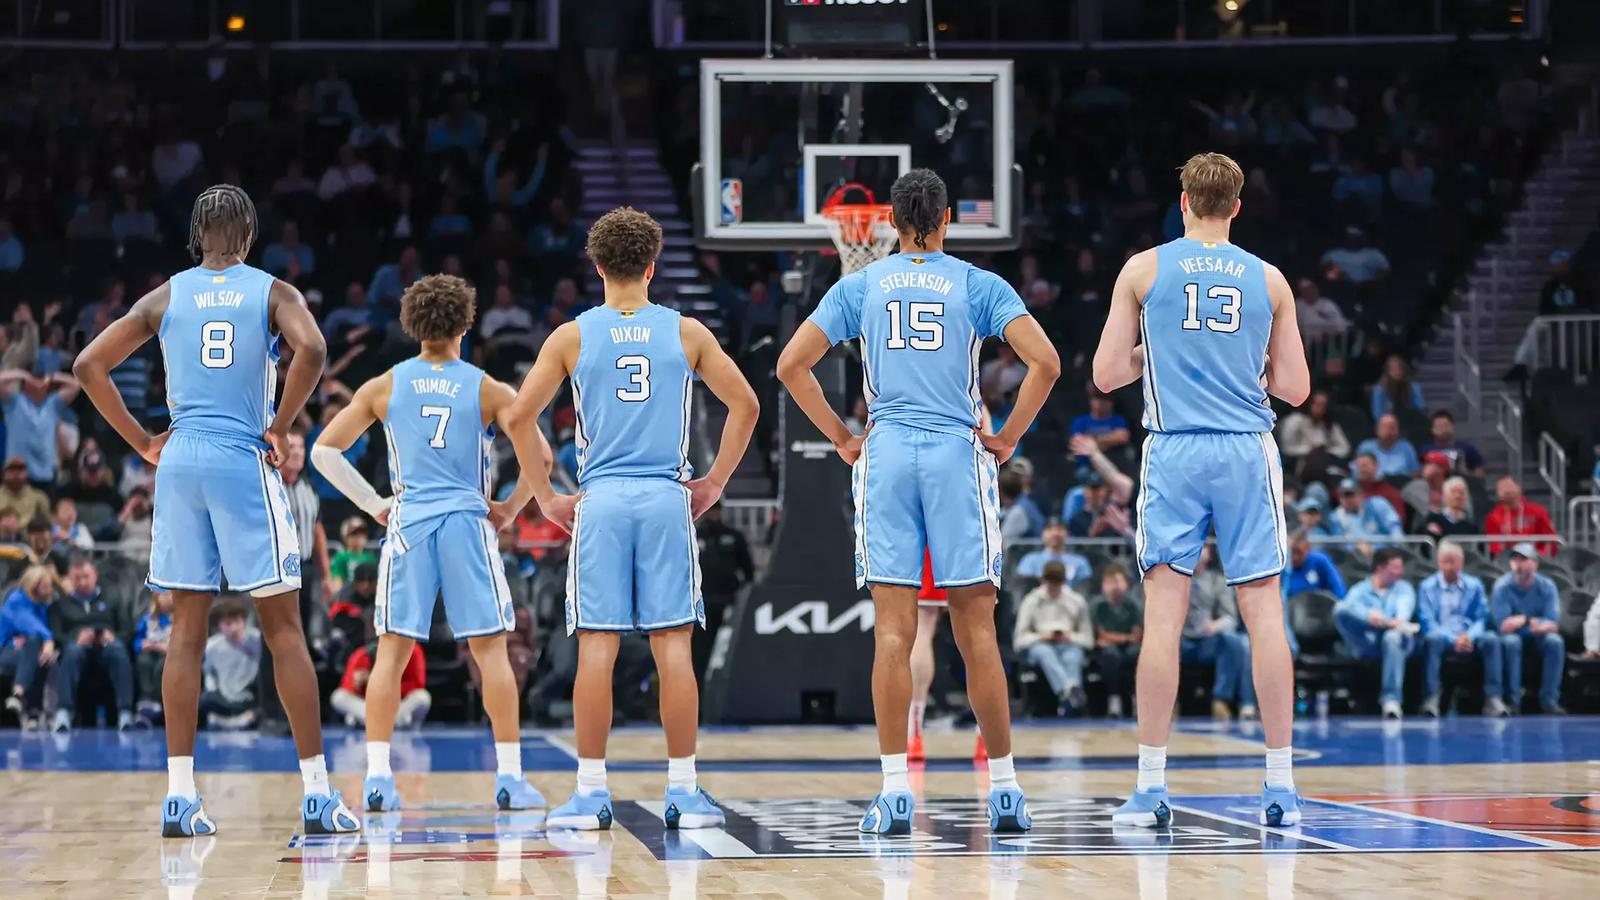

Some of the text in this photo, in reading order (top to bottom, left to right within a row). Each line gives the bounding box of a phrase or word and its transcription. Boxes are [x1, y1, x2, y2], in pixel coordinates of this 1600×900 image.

[1178, 257, 1247, 278] VEESAAR
[880, 271, 955, 296] STEVENSON
[193, 290, 245, 310] WILSON
[1181, 282, 1243, 334] 13
[610, 326, 651, 344] DIXON
[886, 300, 945, 351] 15
[200, 320, 235, 369] 8
[410, 378, 461, 399] TRIMBLE
[615, 354, 651, 402] 3
[420, 404, 452, 449] 7
[168, 799, 179, 817] 0
[307, 797, 317, 815] 0
[896, 796, 907, 815] 0
[1000, 792, 1011, 811] 0
